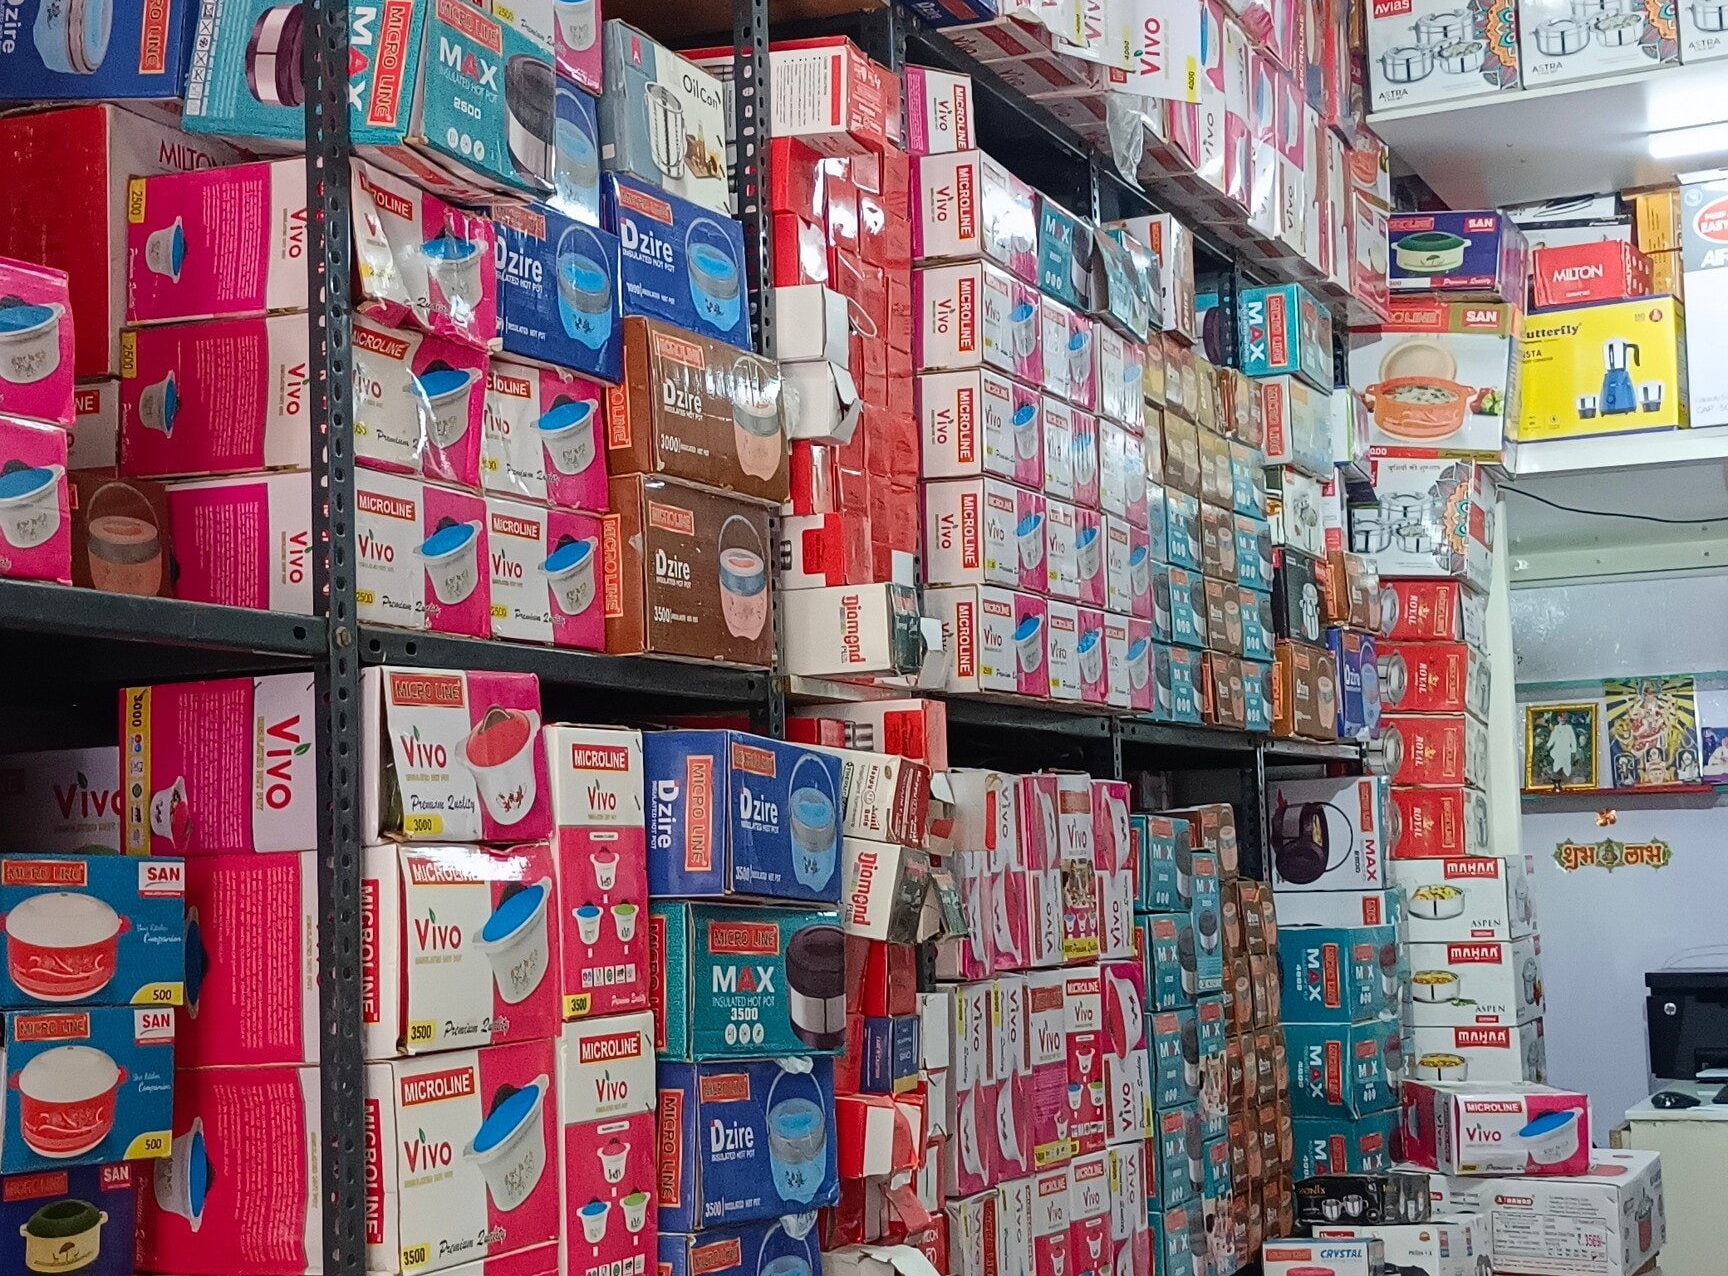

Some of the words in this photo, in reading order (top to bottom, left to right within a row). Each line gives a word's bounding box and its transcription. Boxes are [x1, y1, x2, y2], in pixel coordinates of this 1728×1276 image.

[144, 26, 166, 69] LINE
[1141, 18, 1161, 76] Vivo
[1187, 70, 1195, 90] 4000
[1379, 88, 1408, 100] ASTRA
[954, 86, 965, 148] MICROLINE
[129, 188, 143, 216] 2500
[1469, 218, 1493, 229] SAN
[621, 219, 674, 262] Dzire
[1553, 264, 1603, 283] MILTON
[937, 299, 953, 333] Vivo
[959, 279, 975, 351] MICROLINE
[1248, 301, 1265, 362] MAX
[1525, 324, 1579, 339] utterfly
[287, 363, 308, 416] Vivo
[663, 382, 702, 415] Dzire
[958, 389, 973, 462] MICROLINE
[359, 495, 413, 518] MICROLINE
[493, 518, 539, 537] MICROLINE
[940, 514, 955, 549] Vivo
[358, 530, 394, 563] Vivo
[492, 551, 523, 579] Vivo
[1408, 594, 1418, 625] ROYAL
[957, 603, 973, 676] MICROLINE
[394, 681, 432, 701] MICRO
[436, 680, 461, 700] LINE
[131, 694, 141, 728] 3000
[267, 715, 311, 809] Vivo
[575, 749, 627, 767] MICROLINE
[1415, 735, 1424, 766] ROYAL
[411, 795, 444, 811] Premium
[588, 780, 616, 811] Vivo
[692, 763, 709, 819] MICRO
[740, 787, 779, 824] Dzire
[413, 819, 433, 831] 3000
[657, 780, 678, 849] Dzire
[688, 823, 706, 867] LINE
[1366, 839, 1377, 881] MAX
[1563, 846, 1594, 869] शुभ
[1625, 847, 1662, 865] लाभ
[147, 867, 180, 881] SAN
[415, 909, 461, 951] Vivo
[712, 928, 746, 948] MICRO
[749, 926, 775, 945] LINE
[1471, 919, 1501, 927] ASPEN
[1308, 948, 1321, 1001] MAX
[152, 989, 172, 1000] 500
[570, 997, 587, 1011] 3500
[713, 997, 746, 1007] INSULATED
[747, 997, 761, 1007] HOT
[762, 997, 775, 1007] POT
[1475, 1005, 1505, 1013] ASPEN
[142, 1014, 170, 1028] SAN
[411, 1024, 431, 1039] 3500
[595, 1070, 628, 1103] Vivo
[1311, 1045, 1323, 1098] MAX
[404, 1075, 472, 1103] MICROLINE
[1122, 1083, 1132, 1131] Vivo
[1467, 1103, 1519, 1112] MICROLINE
[404, 1128, 452, 1172] Vivo
[711, 1120, 754, 1151] Dzire
[103, 1167, 129, 1182] SAN
[403, 1249, 425, 1266] 3500
[1321, 1249, 1362, 1259] CRYSTAL
